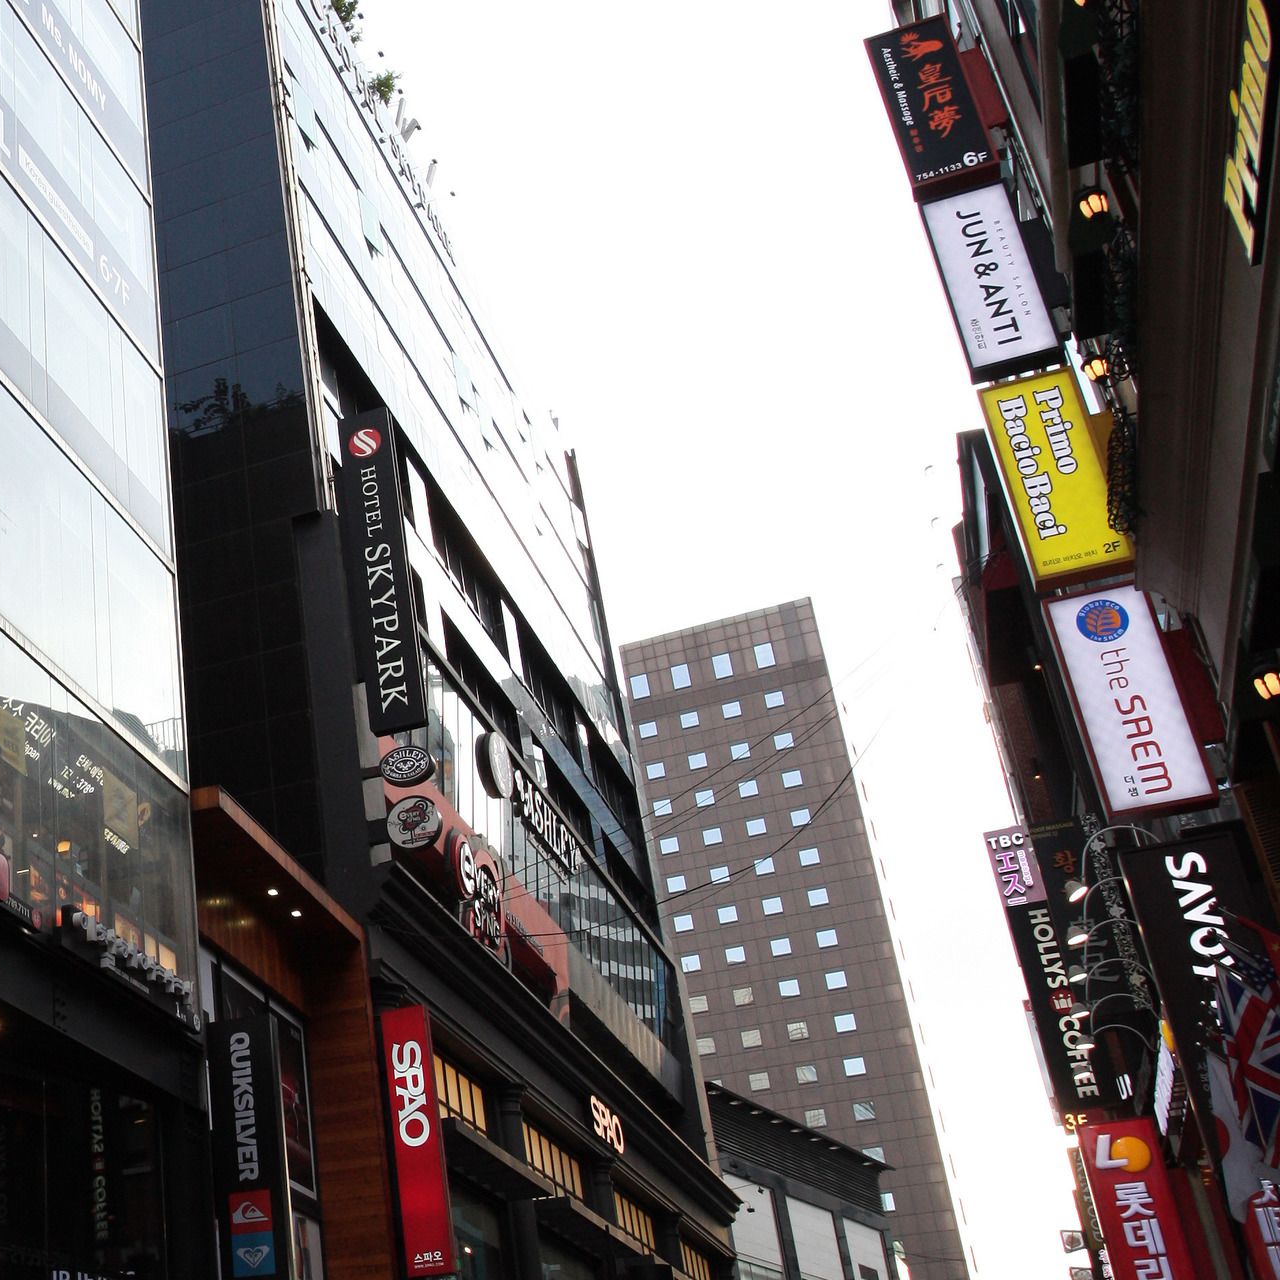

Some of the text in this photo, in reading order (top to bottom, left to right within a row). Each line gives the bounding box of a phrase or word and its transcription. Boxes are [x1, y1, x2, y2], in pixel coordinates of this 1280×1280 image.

[68, 43, 108, 112] NOMY
[895, 90, 915, 127] Massage
[962, 150, 989, 167] 6F
[955, 210, 994, 259] JUN
[973, 261, 999, 280] &
[993, 220, 1032, 317] BEAUTY SALON
[979, 284, 1023, 346] ANTI
[1032, 385, 1079, 475] Primo
[1103, 539, 1121, 555] 2F
[360, 464, 409, 715] HOTEL SKYPARK
[1100, 647, 1174, 795] the SAEM
[523, 783, 583, 878] ASHLEY
[987, 832, 1025, 851] TBC
[1165, 851, 1243, 982] SAVOY
[1028, 908, 1069, 989] HOLLYS
[1058, 1015, 1102, 1100] COFFEE
[228, 1031, 261, 1183] QUIKSILVER
[391, 1039, 431, 1148] SPAO
[590, 1094, 625, 1155] SPAO
[1063, 1112, 1089, 1131] 3F
[413, 1250, 444, 1264] 스파오
